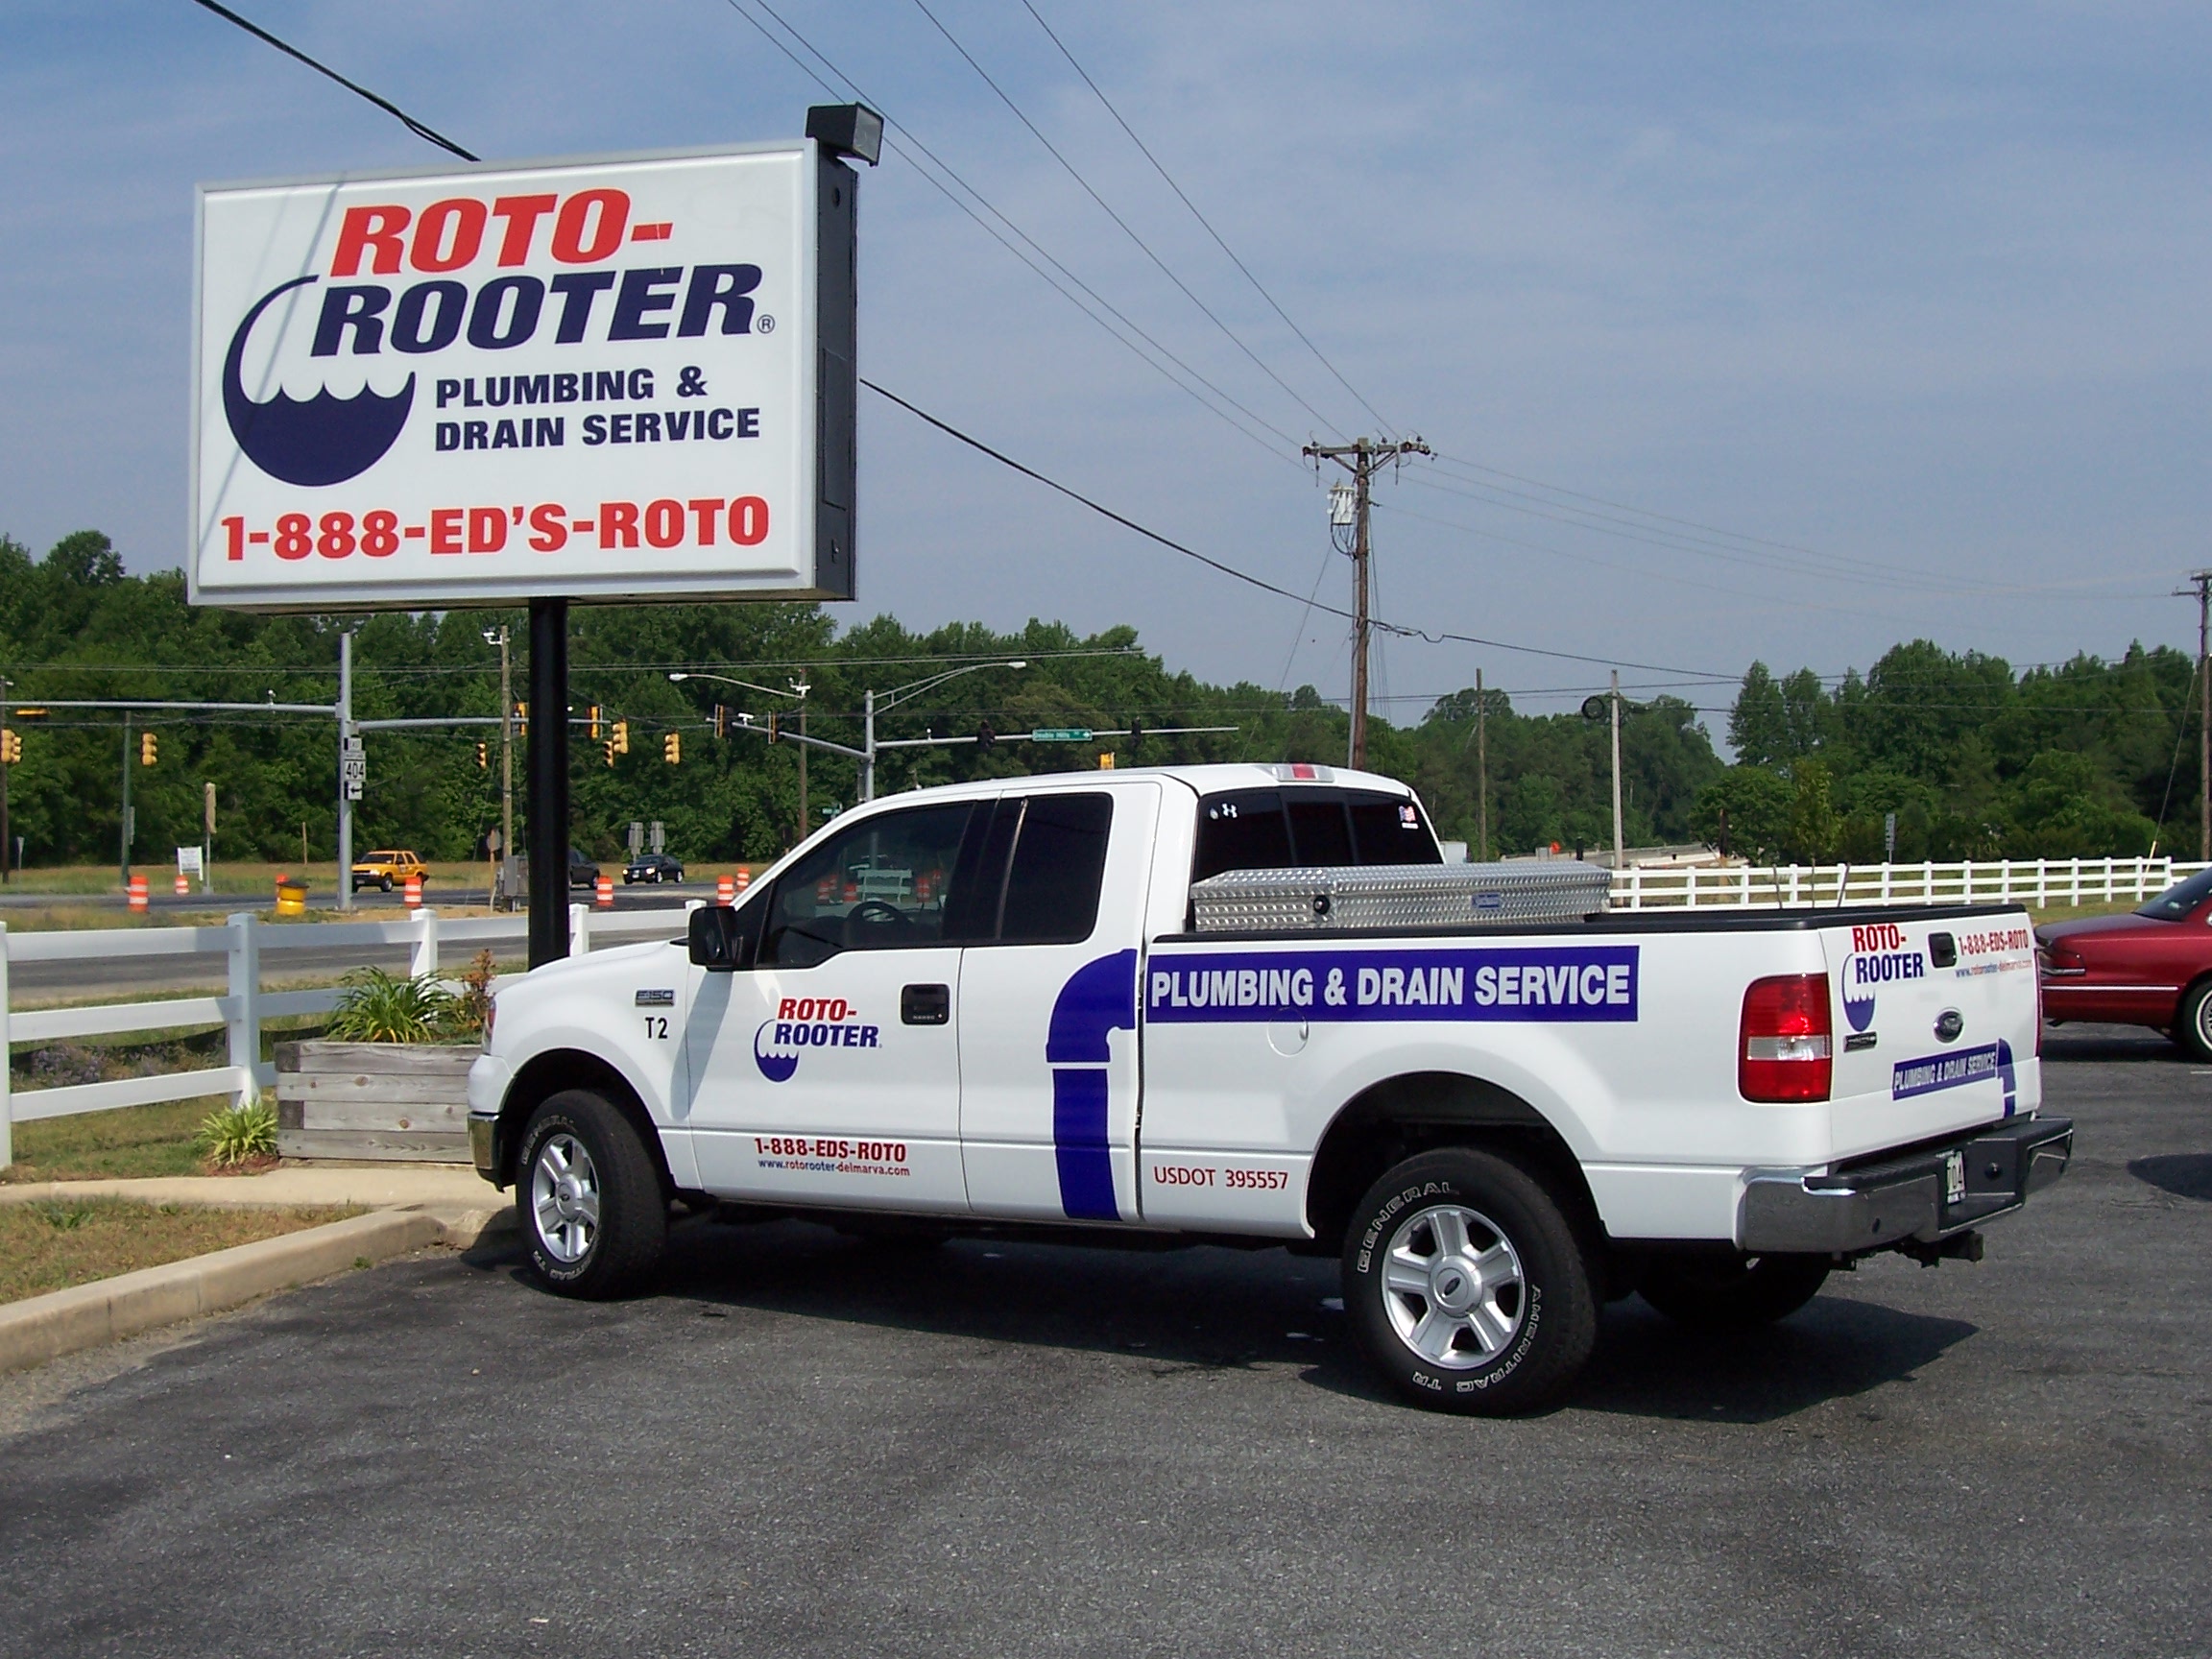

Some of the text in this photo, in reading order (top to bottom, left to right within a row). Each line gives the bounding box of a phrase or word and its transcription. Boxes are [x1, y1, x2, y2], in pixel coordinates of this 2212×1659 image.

[330, 187, 674, 277] ROTO-
[309, 263, 762, 357] ROOTER
[436, 366, 709, 409] PLUMBING &
[435, 408, 760, 452] DRAIN SERVICE
[221, 495, 772, 563] 1-888-ED'S-ROTO
[346, 762, 364, 779] 404
[1852, 924, 1907, 953] ROTO-
[1958, 928, 2029, 956] 1-888-EDS-ROTO
[1855, 951, 1925, 985] ROOTER
[1151, 964, 1631, 1008] PLUMBING & DRAIN SERVICE
[778, 998, 858, 1022] ROTO-
[774, 1023, 879, 1048] ROOTER
[1894, 1063, 1936, 1091] PLUMBING
[1944, 1057, 1967, 1081] DRAIN
[1967, 1050, 1996, 1075] SERVICE
[755, 1138, 907, 1163] 1-888-EDS-ROTO
[757, 1158, 911, 1177] www.rotorooter-delmarva.com
[1154, 1166, 1288, 1190] USDOT 395557
[1357, 1181, 1459, 1273] GENERAL
